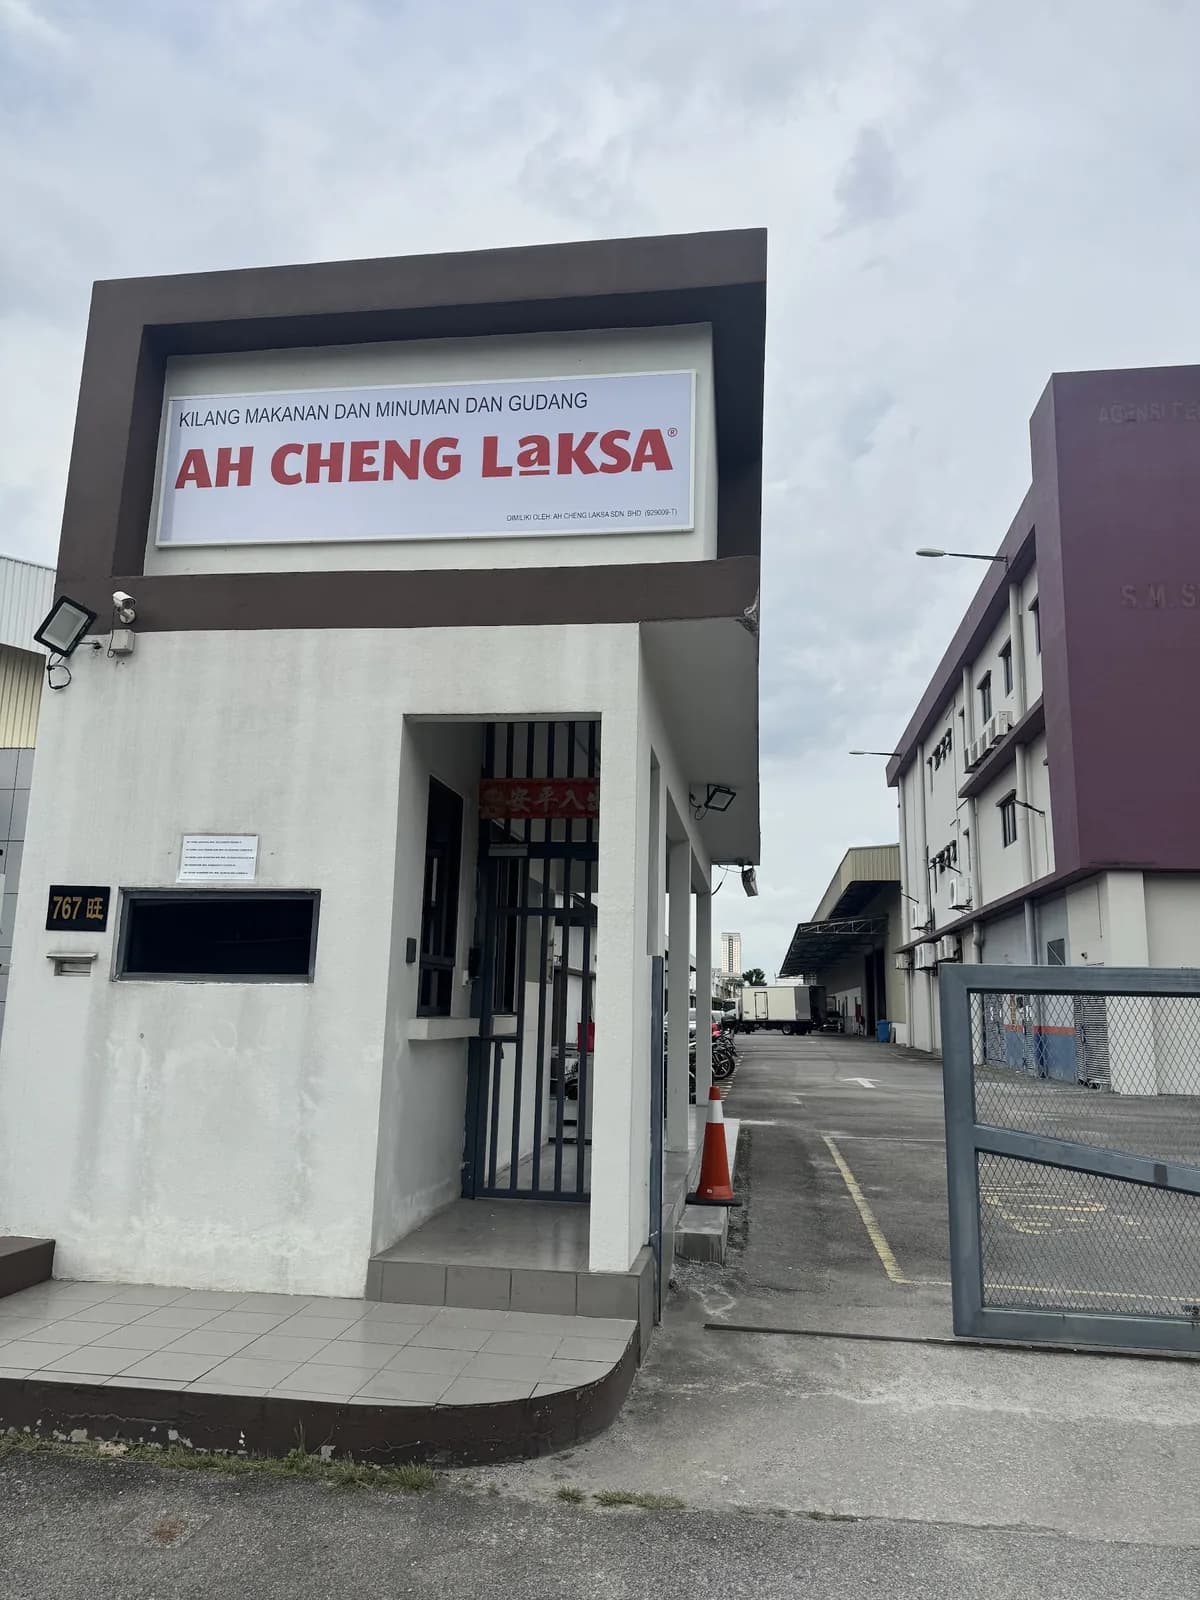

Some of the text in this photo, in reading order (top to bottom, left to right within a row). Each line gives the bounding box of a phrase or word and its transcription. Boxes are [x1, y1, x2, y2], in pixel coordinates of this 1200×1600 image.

[179, 392, 588, 427] KILANG MAKANAN DAN MINUMAN DAN GUDANG
[175, 446, 254, 489] AH
[271, 436, 461, 485] CHENG
[563, 511, 587, 519] CHENG
[588, 510, 610, 519] LAKSA
[53, 895, 104, 920] 767 旺
